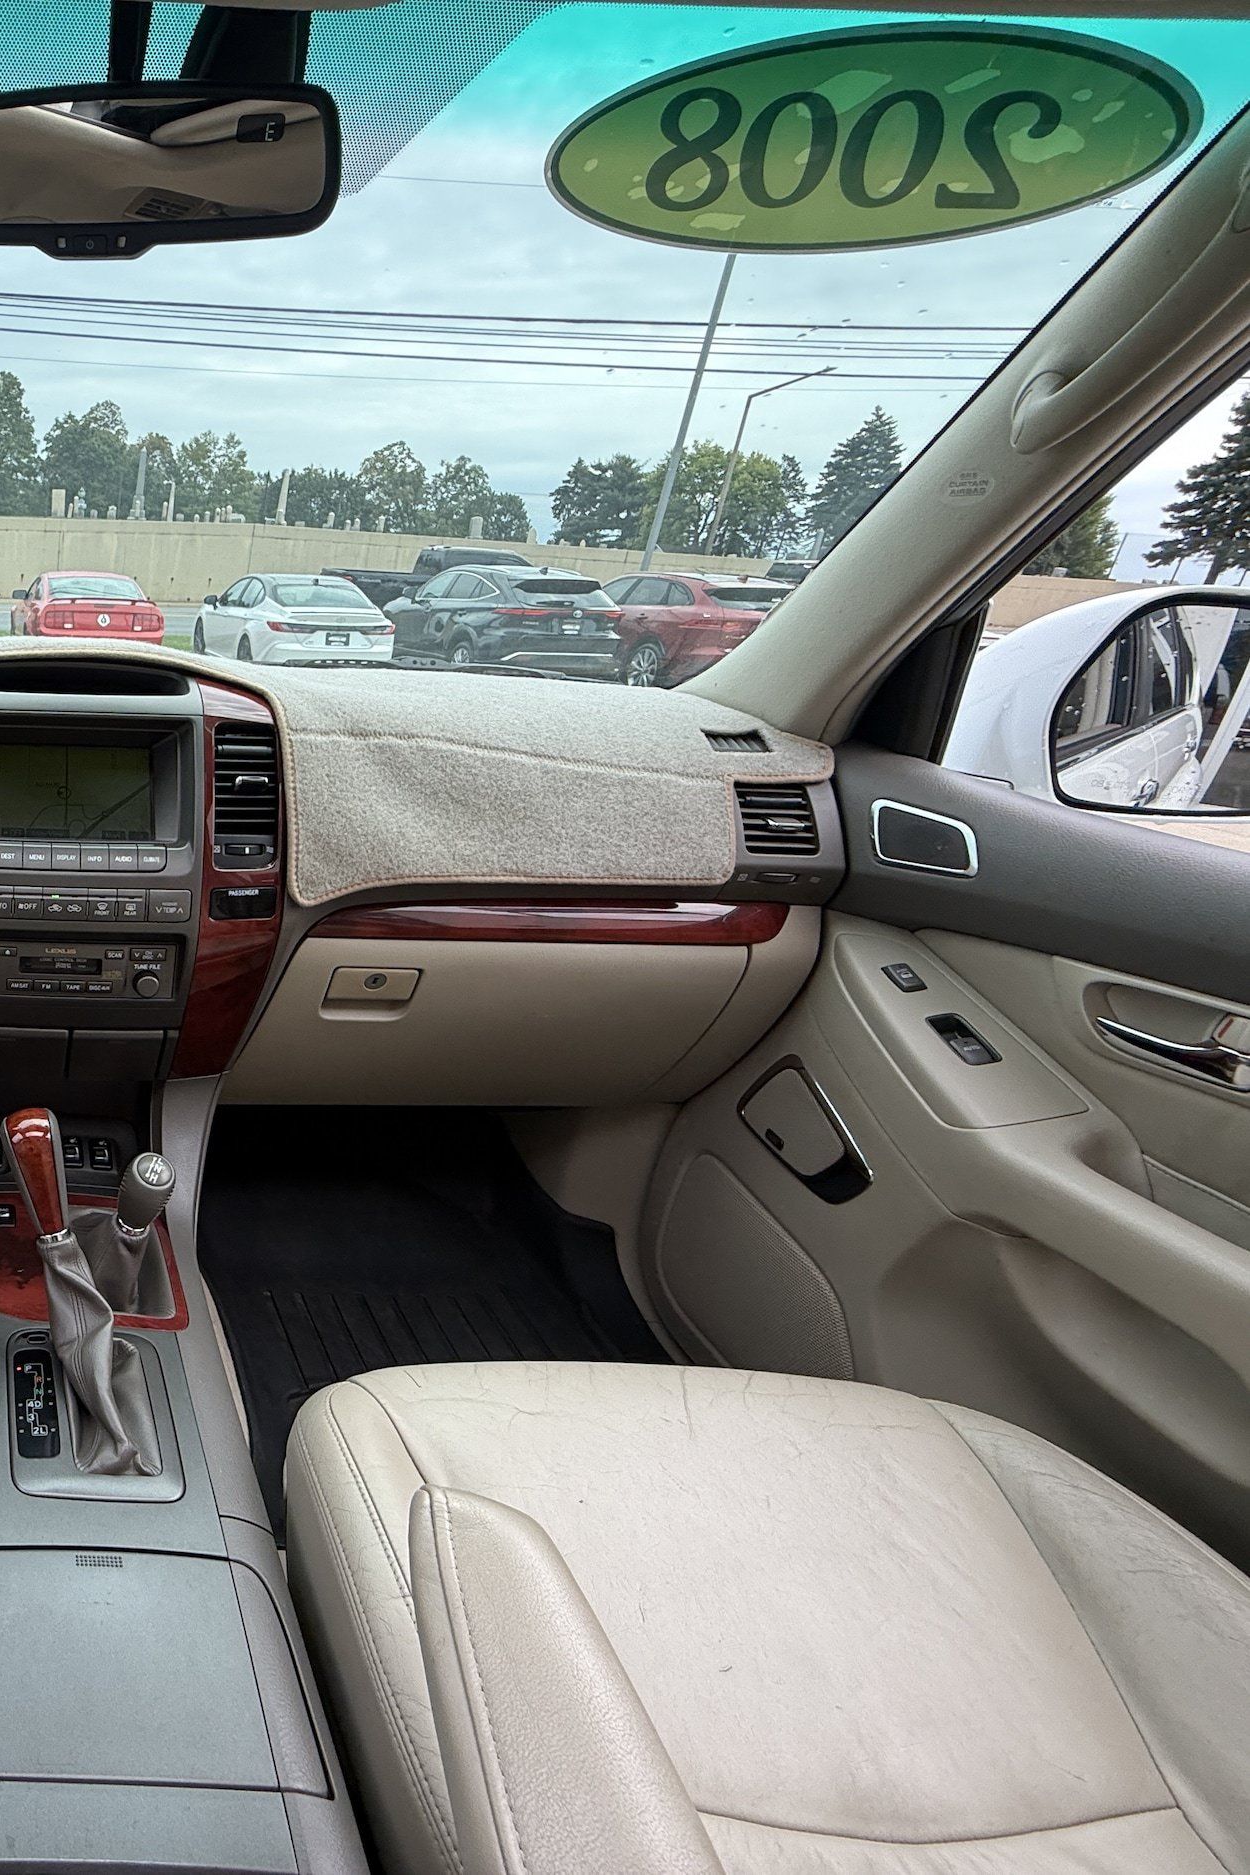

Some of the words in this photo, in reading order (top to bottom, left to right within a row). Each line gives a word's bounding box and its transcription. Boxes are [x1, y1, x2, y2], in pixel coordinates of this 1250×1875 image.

[264, 121, 276, 142] E
[949, 480, 989, 488] CURTAIN
[949, 487, 987, 496] AIRBAG
[29, 853, 45, 861] MENU
[56, 854, 77, 862] DISPLAY
[87, 855, 103, 863] INFO
[114, 855, 133, 863] AUDIO
[228, 889, 260, 897] PASSENGER
[23, 902, 38, 910] OFF
[45, 947, 77, 955] LEXUS
[153, 1163, 163, 1174] N
[149, 1172, 159, 1184] H
[28, 1413, 35, 1421] 3
